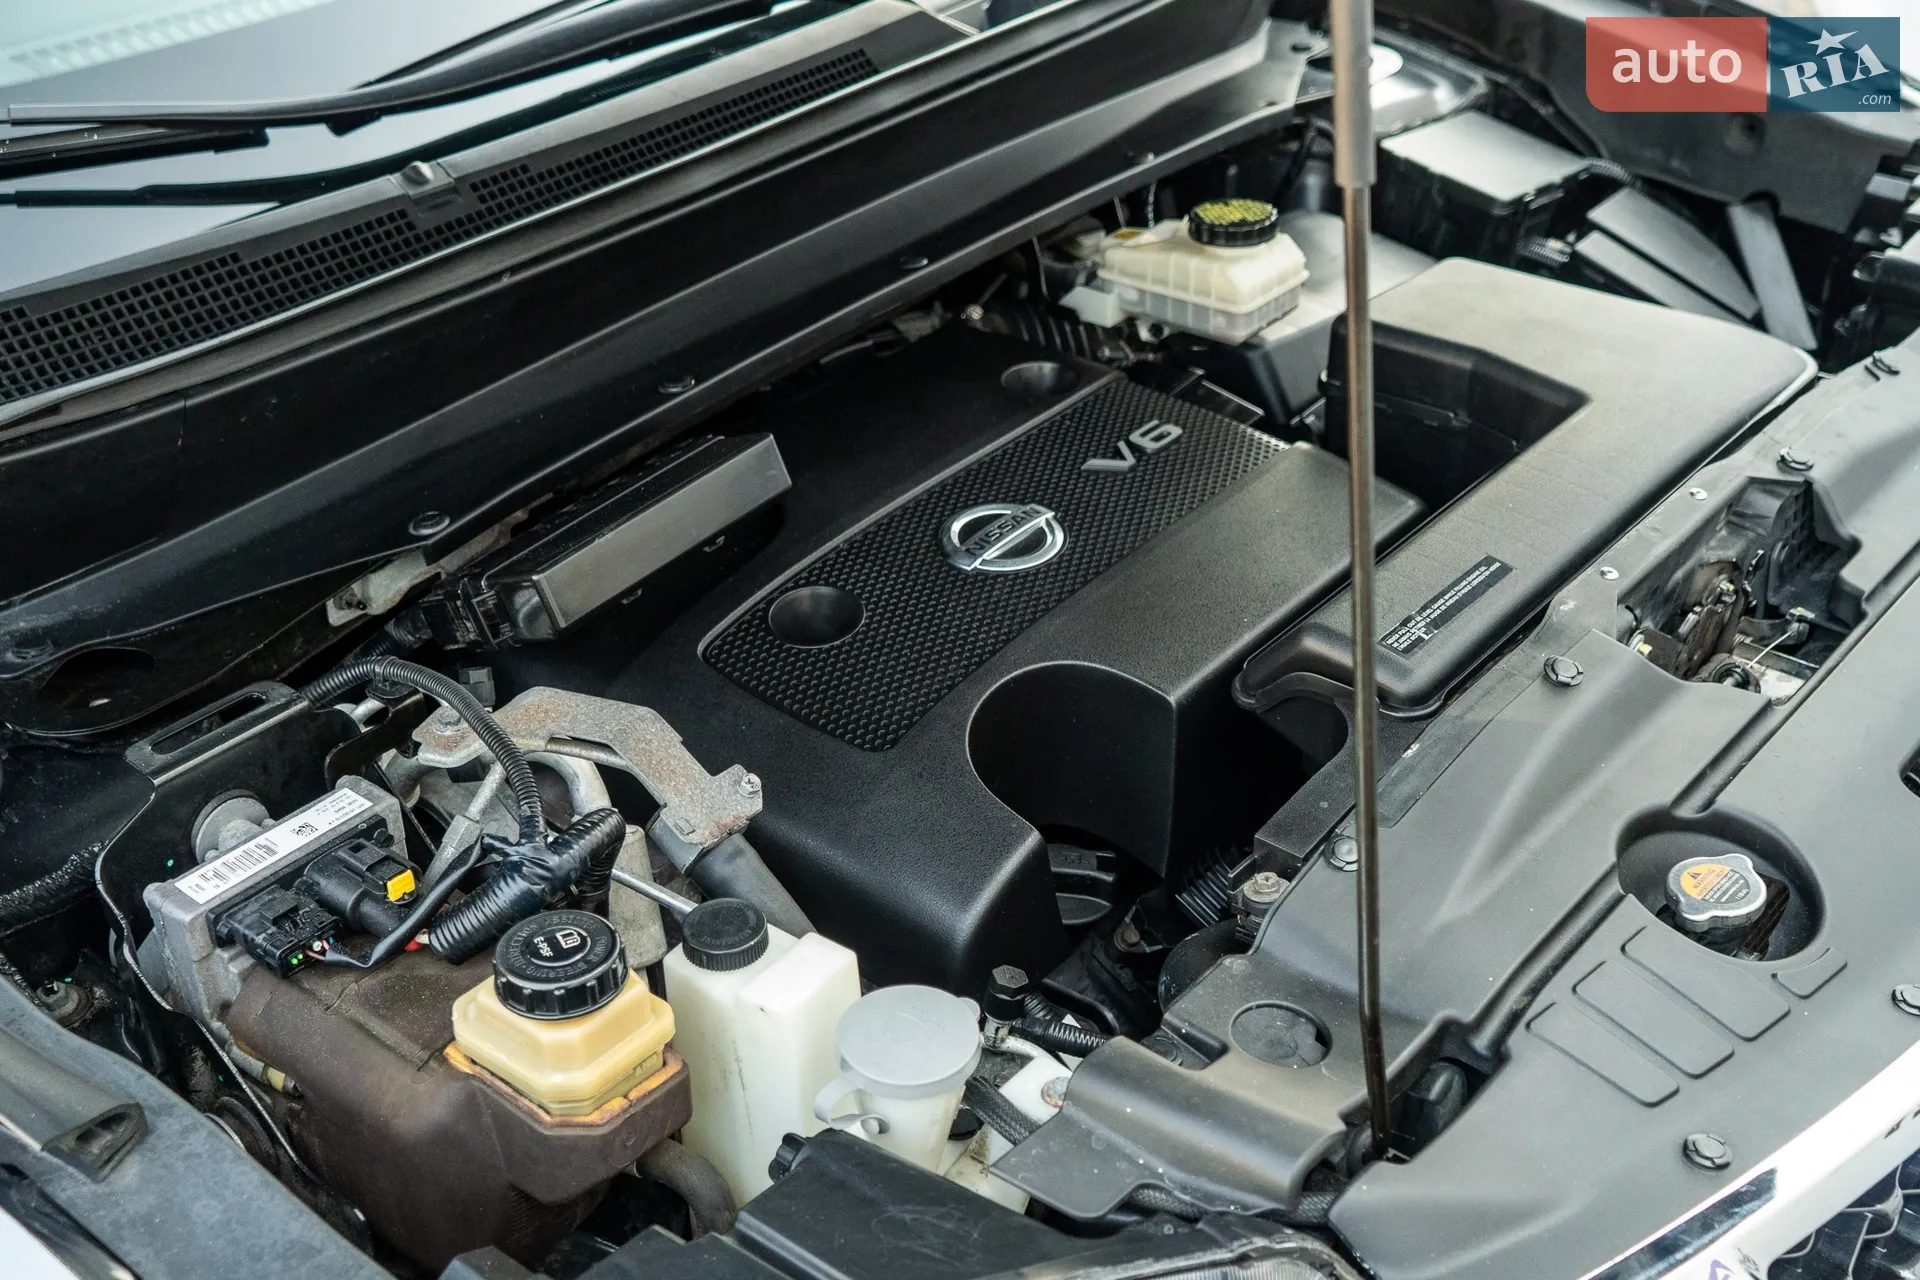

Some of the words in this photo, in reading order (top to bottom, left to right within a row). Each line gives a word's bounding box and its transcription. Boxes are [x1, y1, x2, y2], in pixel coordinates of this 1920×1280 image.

[1081, 420, 1183, 472] V6
[964, 507, 1041, 556] NISSAN
[533, 936, 555, 958] E-PSF
[526, 961, 587, 978] STEERING
